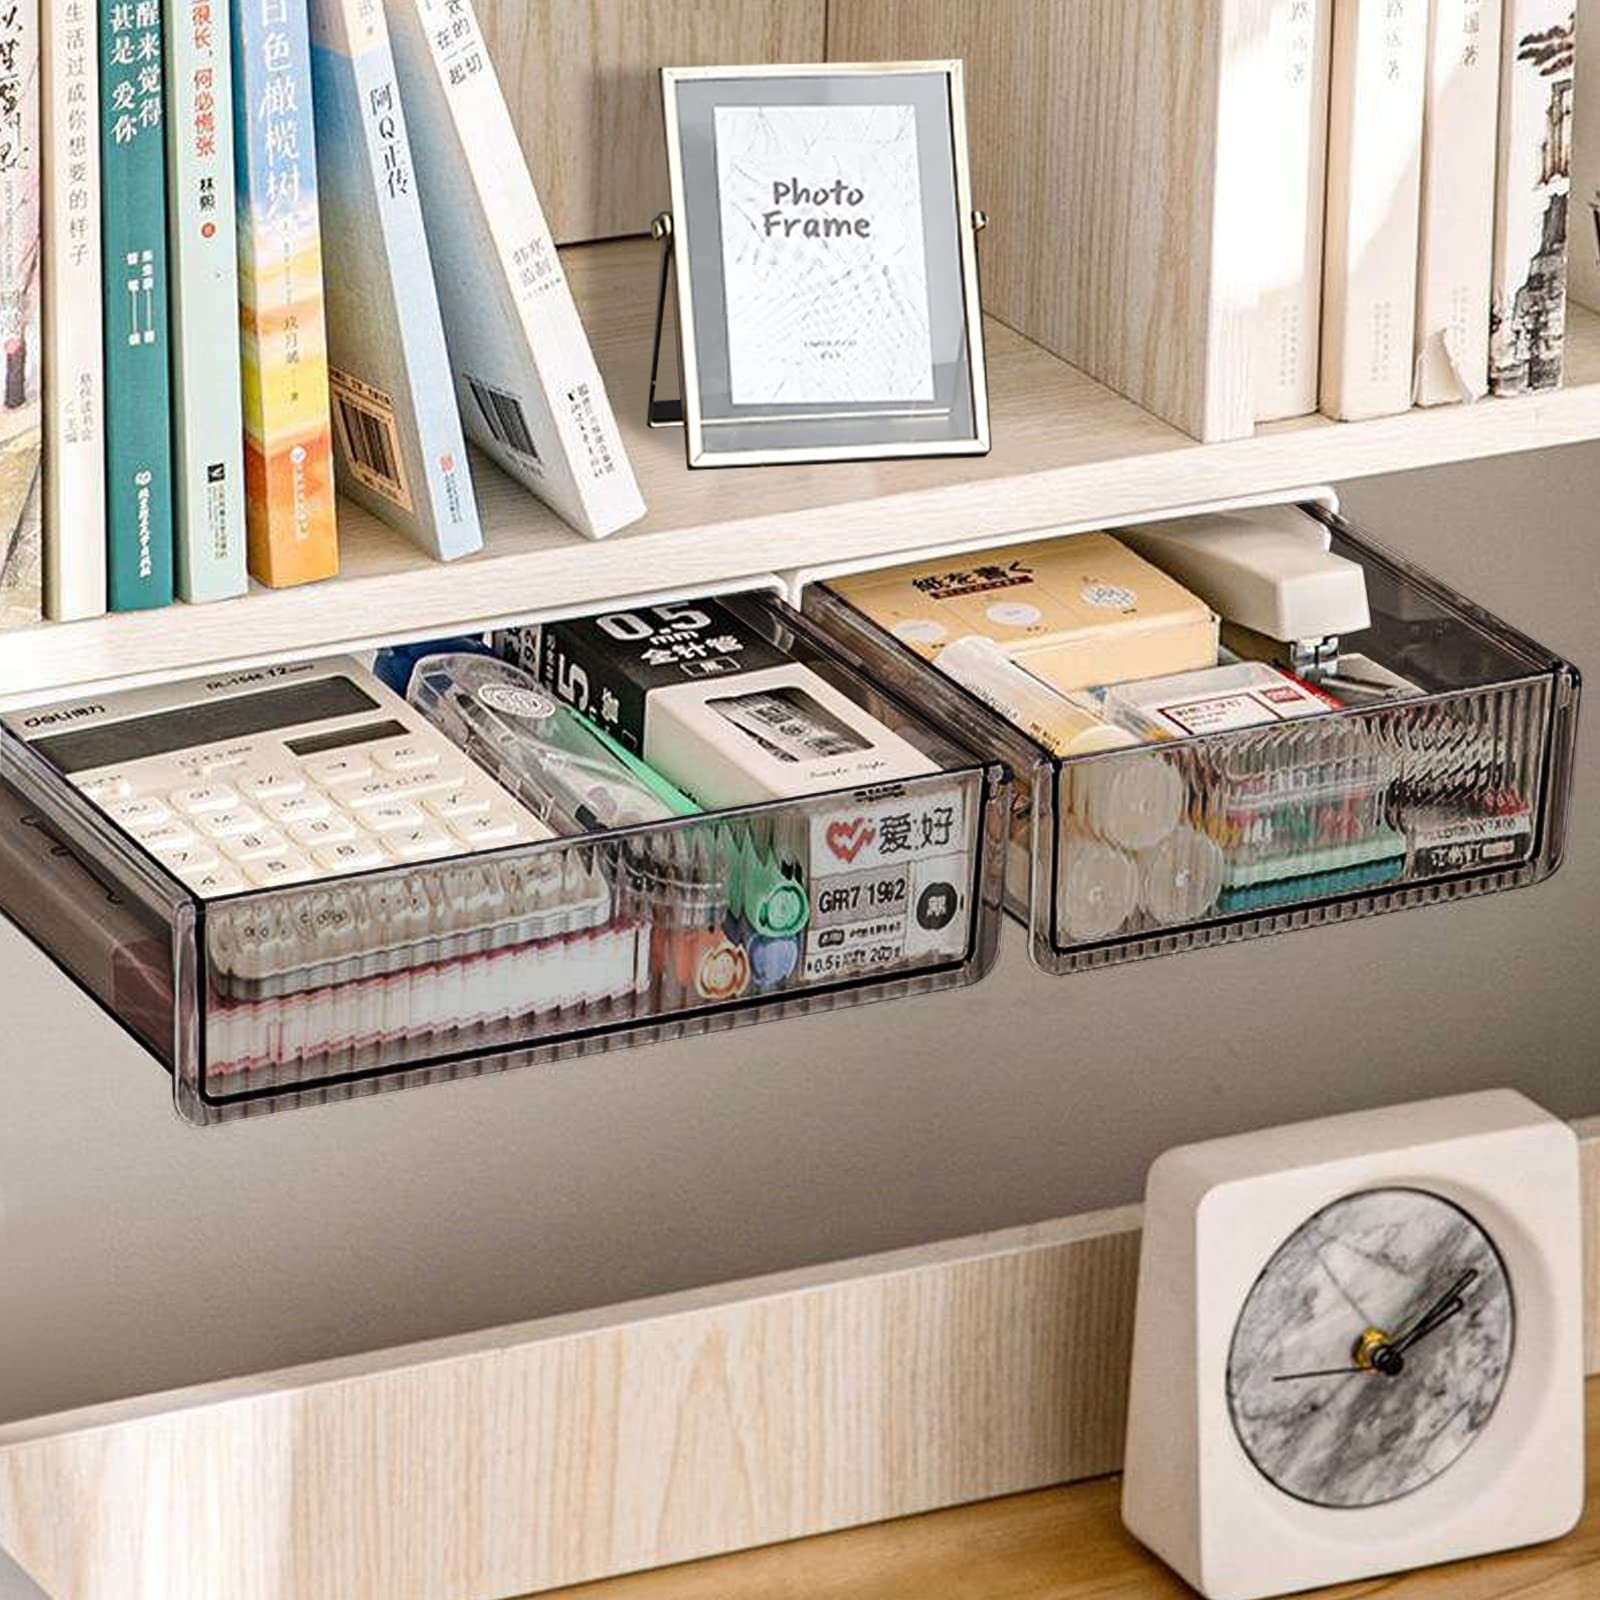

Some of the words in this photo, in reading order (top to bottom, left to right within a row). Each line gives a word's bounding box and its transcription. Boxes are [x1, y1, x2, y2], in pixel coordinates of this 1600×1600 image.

[369, 80, 408, 198] 阿Q正传
[773, 178, 865, 206] Photo
[762, 210, 871, 239] Frame
[878, 807, 954, 855] 爱好
